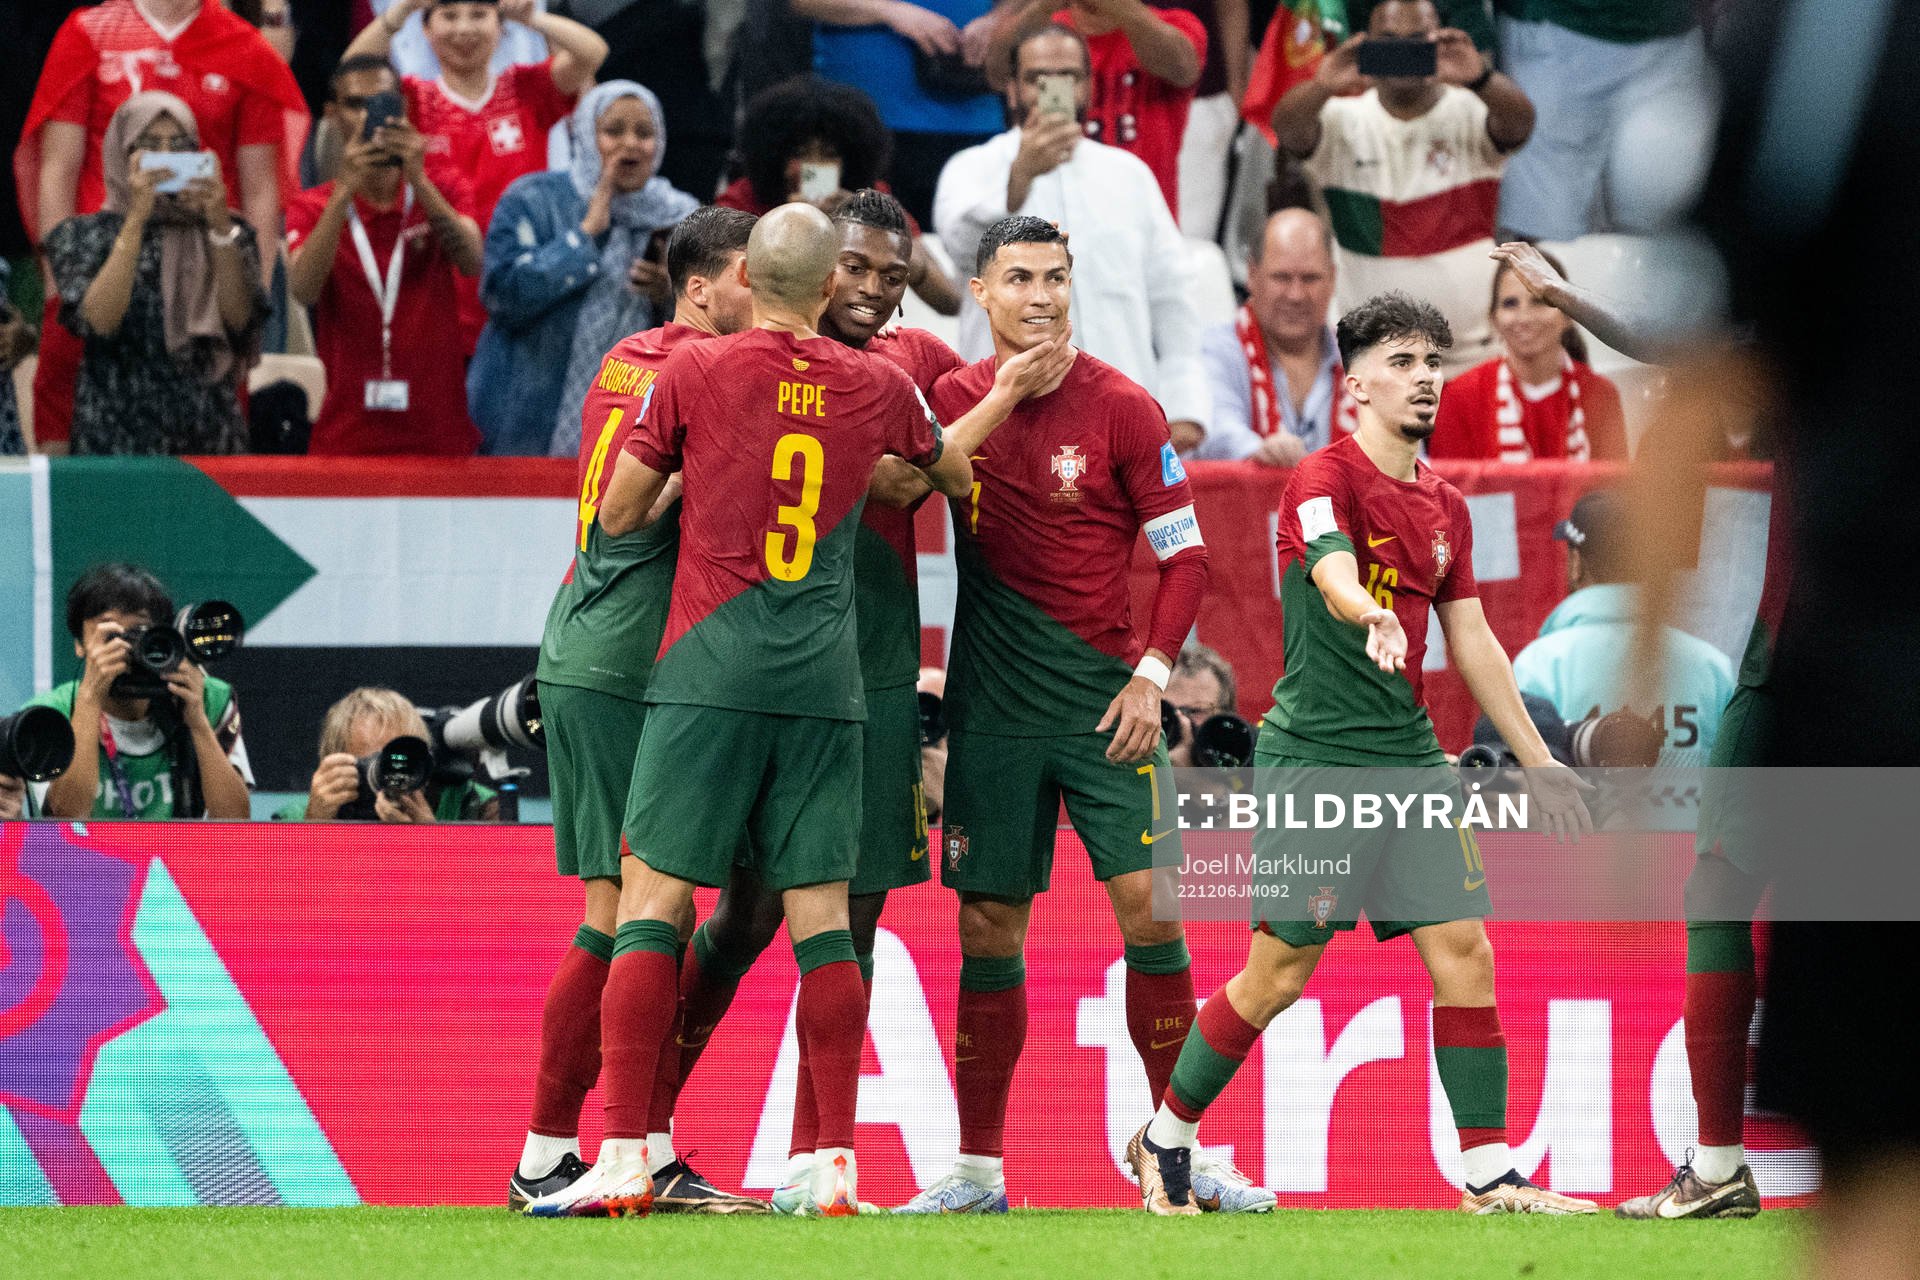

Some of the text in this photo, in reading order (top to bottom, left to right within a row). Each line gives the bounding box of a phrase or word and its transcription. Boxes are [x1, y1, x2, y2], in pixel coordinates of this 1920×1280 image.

[777, 381, 826, 417] PEPE
[578, 407, 625, 553] 4
[765, 433, 824, 582] 3
[1147, 515, 1195, 543] EDUCATION
[1154, 533, 1188, 552] FOR ALL
[1366, 563, 1398, 610] 16
[1136, 763, 1161, 821] 7
[742, 926, 962, 1190] A
